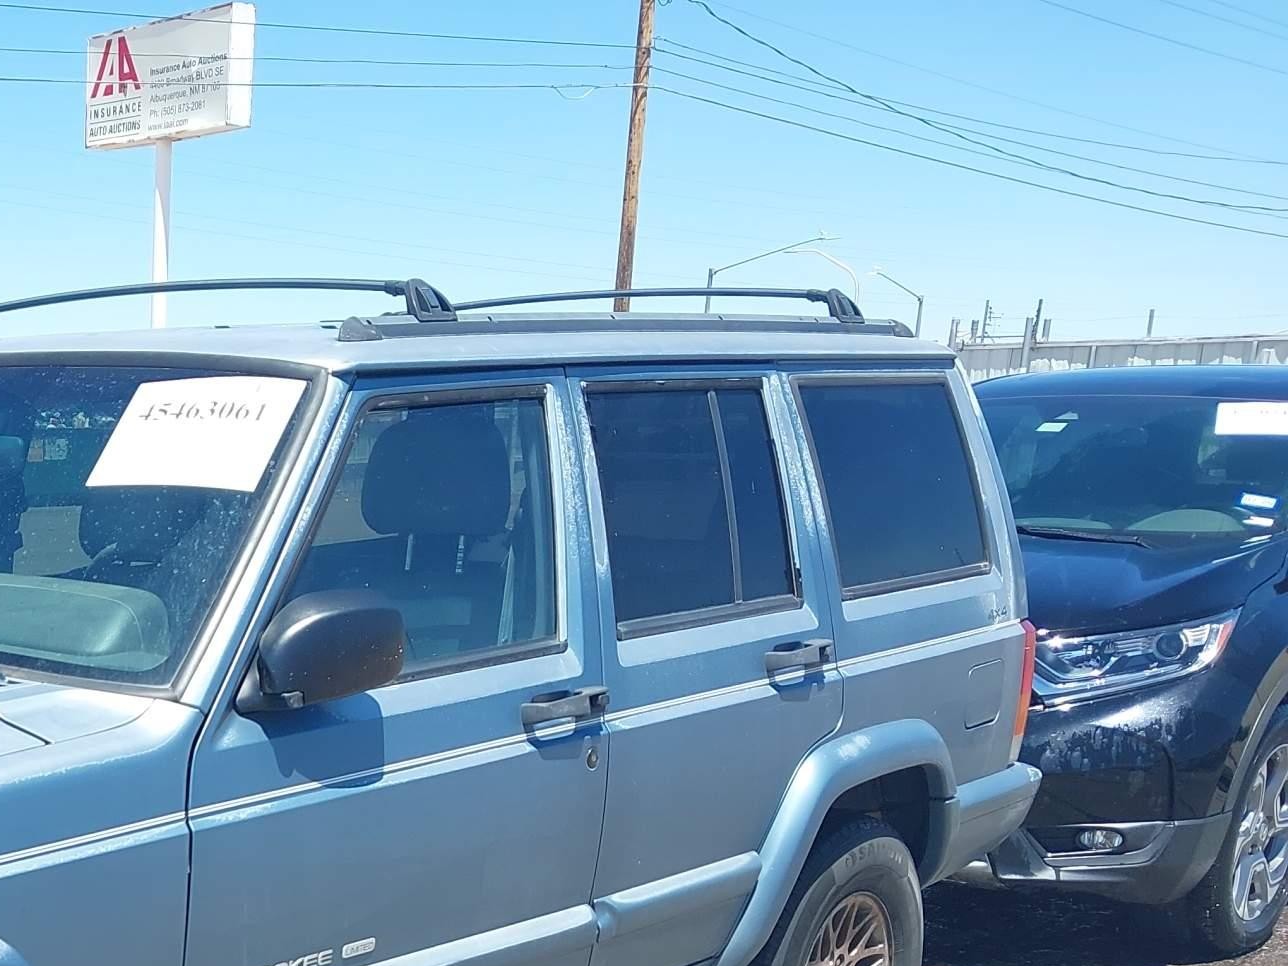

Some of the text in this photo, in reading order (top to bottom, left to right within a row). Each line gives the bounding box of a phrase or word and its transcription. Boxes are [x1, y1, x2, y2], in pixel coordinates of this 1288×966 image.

[150, 52, 228, 77] Insurance Auto Auctions
[196, 68, 214, 81] BLVD
[214, 65, 224, 76] SE
[189, 84, 200, 96] NM
[89, 101, 142, 120] INSURANCE
[89, 119, 141, 138] AUTO AUCTIONS
[139, 401, 266, 421] 45463061
